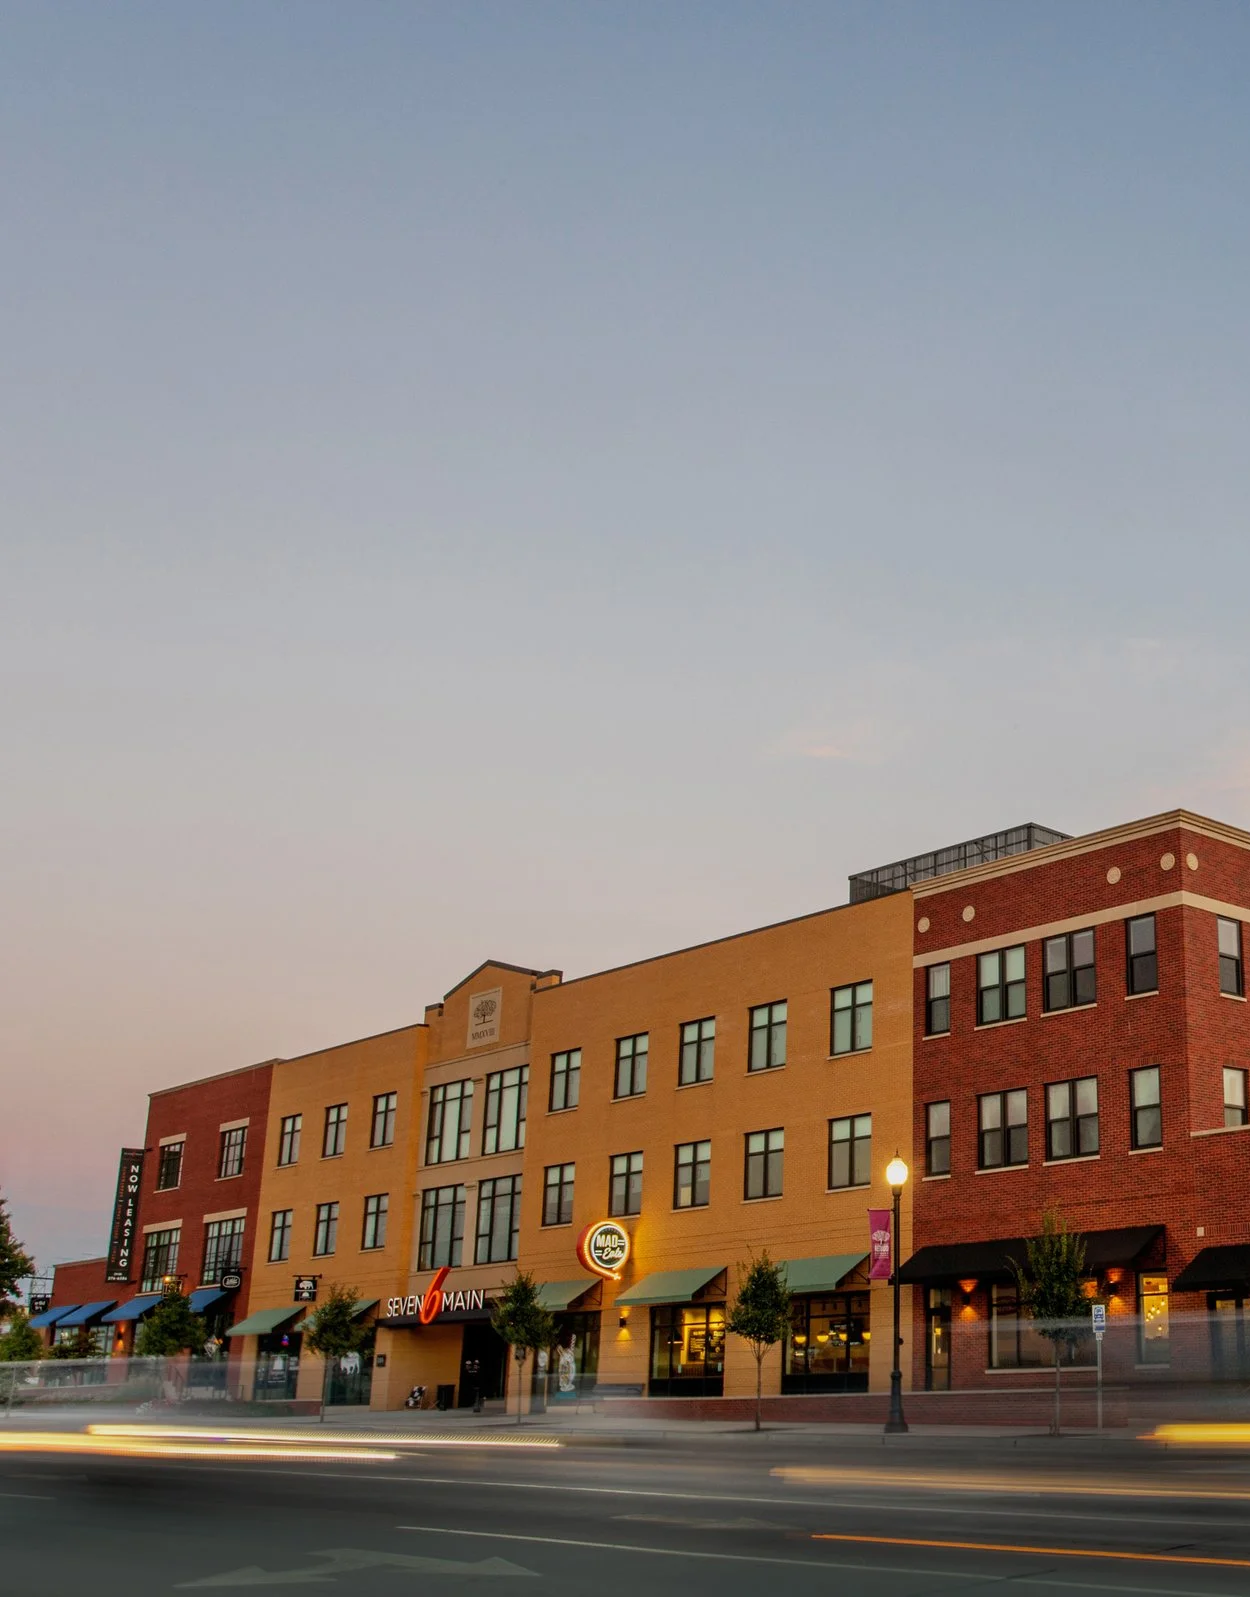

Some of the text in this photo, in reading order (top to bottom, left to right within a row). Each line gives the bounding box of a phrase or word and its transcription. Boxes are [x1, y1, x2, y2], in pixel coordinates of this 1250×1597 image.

[127, 1165, 140, 1193] NOW
[119, 1198, 134, 1267] LEASING
[596, 1234, 618, 1248] MAD
[386, 1294, 425, 1318] SEVEN
[441, 1289, 484, 1313] MAIN
